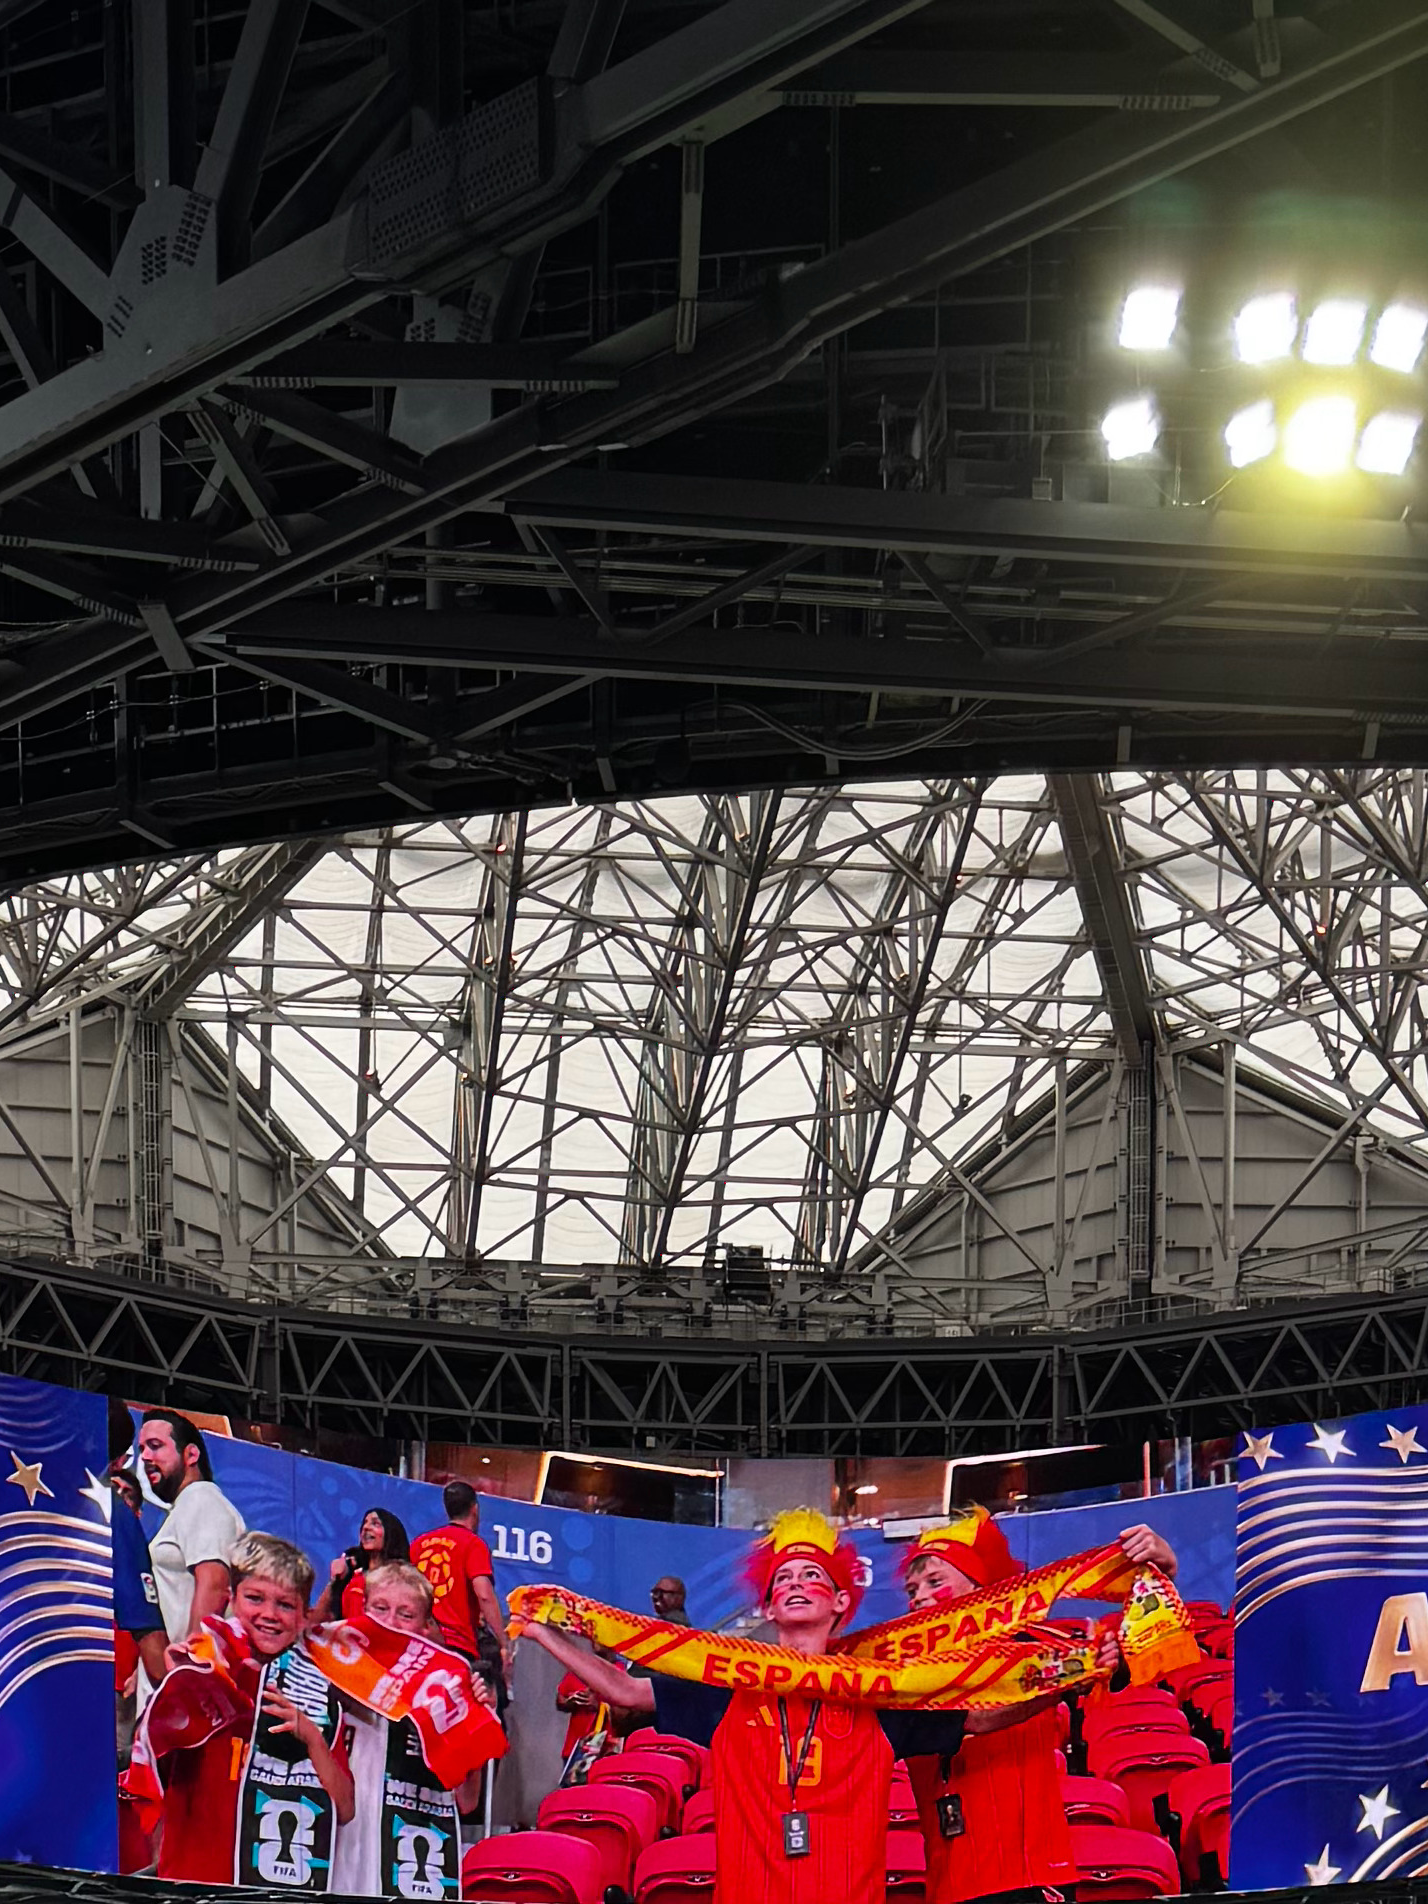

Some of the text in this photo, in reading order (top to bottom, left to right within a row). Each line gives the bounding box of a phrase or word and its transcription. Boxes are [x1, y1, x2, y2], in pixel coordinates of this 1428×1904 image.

[492, 1524, 553, 1564] 116
[874, 1590, 1049, 1662] ESPAÑA
[273, 1864, 298, 1878] FIFA
